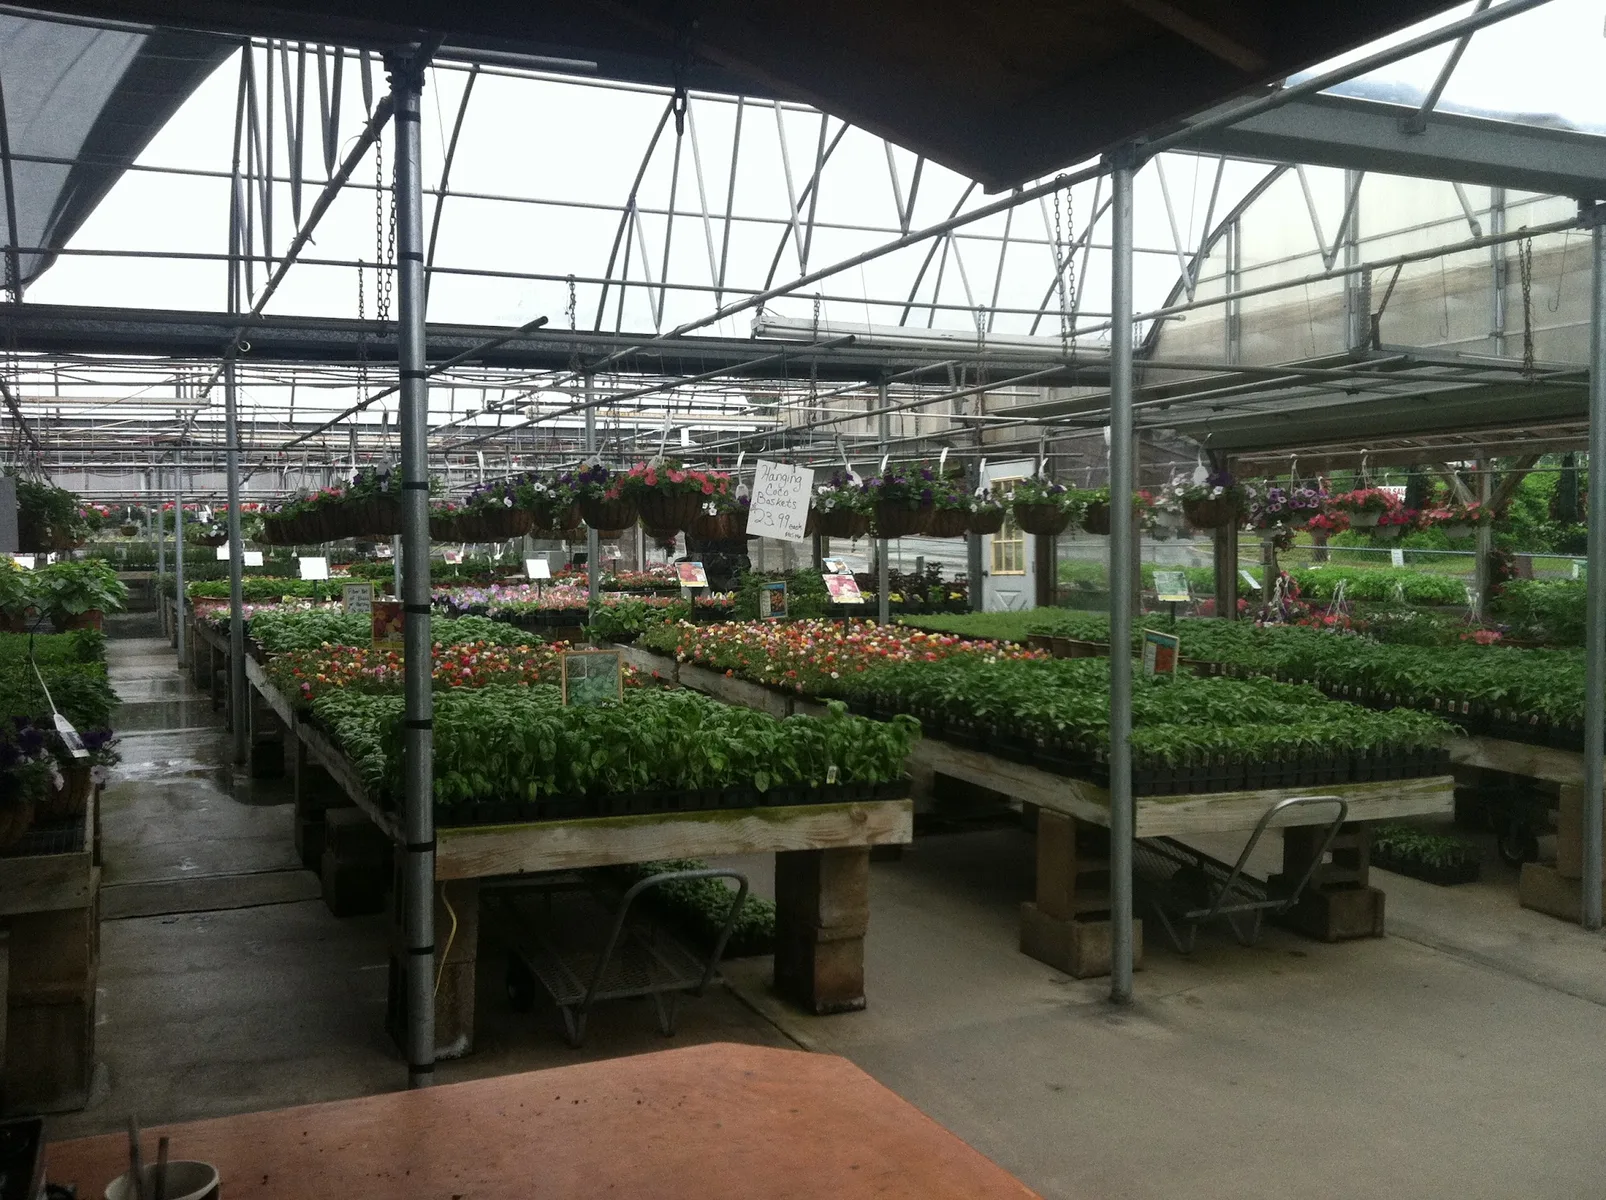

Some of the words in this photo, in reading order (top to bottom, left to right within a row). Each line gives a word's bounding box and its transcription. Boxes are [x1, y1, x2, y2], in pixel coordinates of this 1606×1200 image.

[761, 464, 802, 492] Hanging
[765, 483, 789, 496] Coco
[757, 491, 797, 510] Baskets
